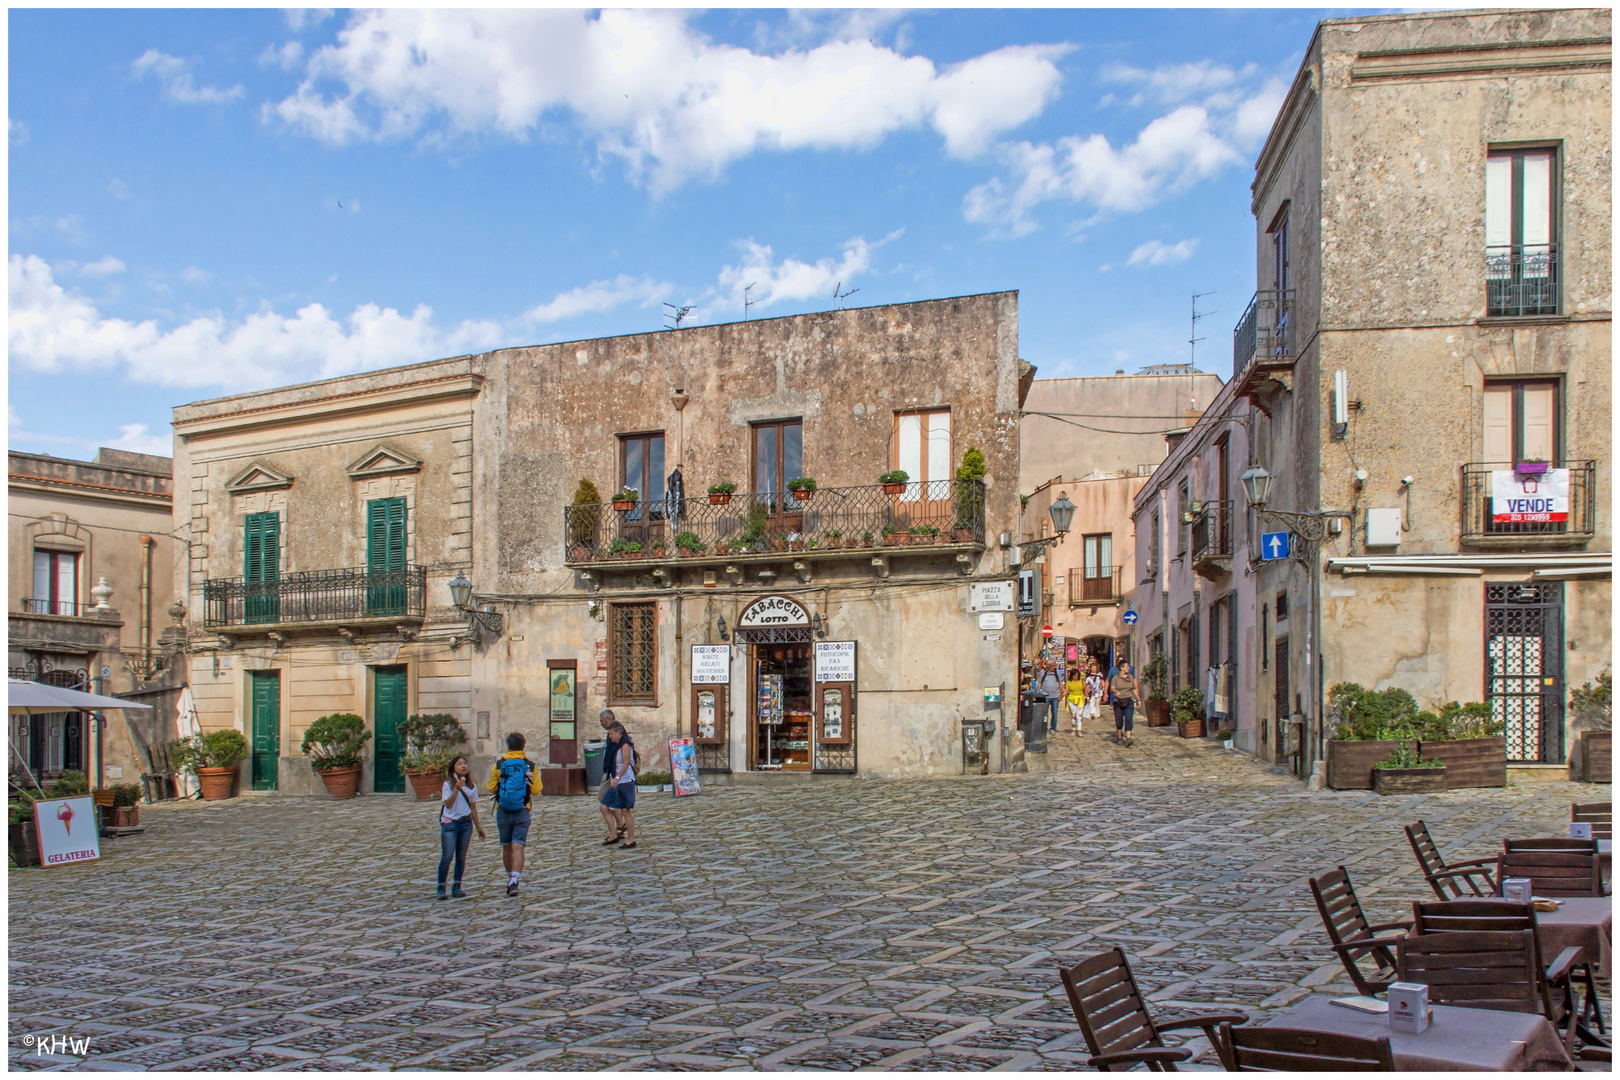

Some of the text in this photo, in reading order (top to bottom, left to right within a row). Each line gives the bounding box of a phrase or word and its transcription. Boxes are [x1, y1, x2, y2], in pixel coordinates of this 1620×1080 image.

[1507, 499, 1554, 512] VENDE
[745, 599, 804, 622] TABACCHI
[48, 849, 96, 863] GELATERIA
